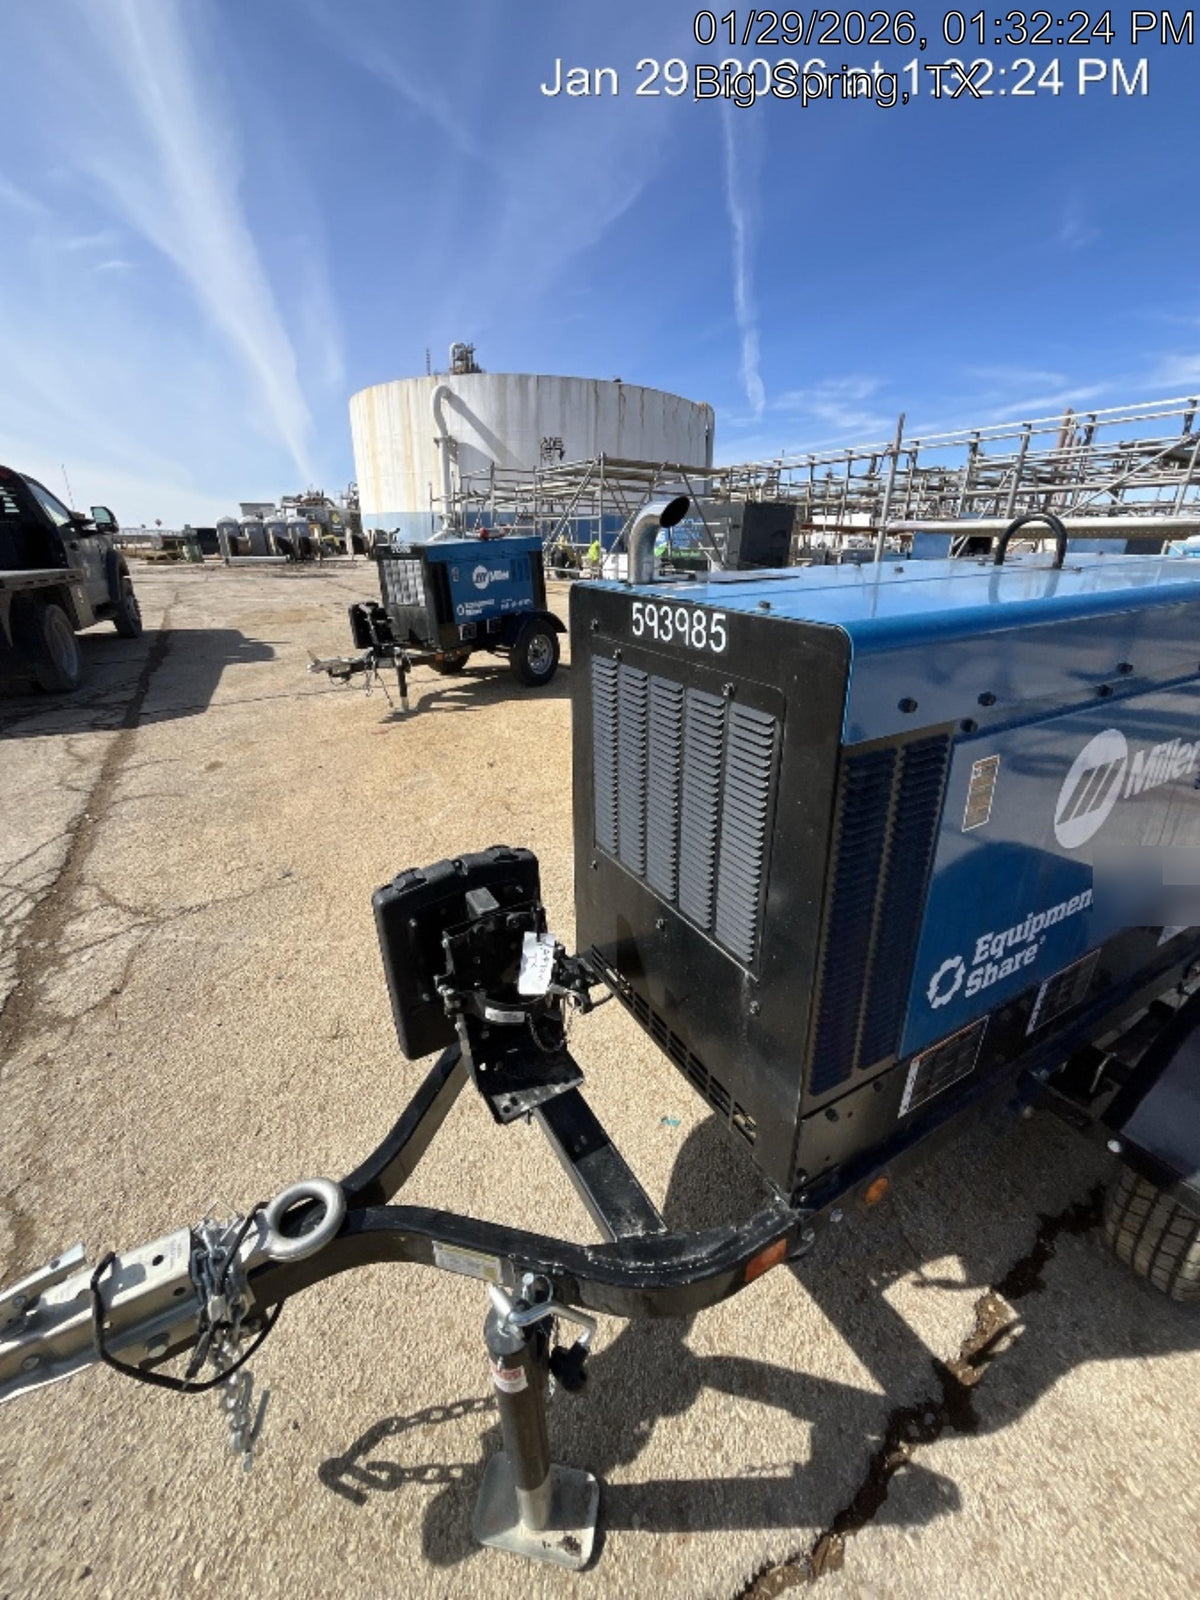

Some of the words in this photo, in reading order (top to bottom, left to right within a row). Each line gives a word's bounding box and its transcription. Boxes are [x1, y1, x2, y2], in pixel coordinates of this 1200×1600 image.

[631, 602, 727, 653] 593985
[972, 888, 1093, 966] Equipmen
[964, 943, 1040, 998] Share
